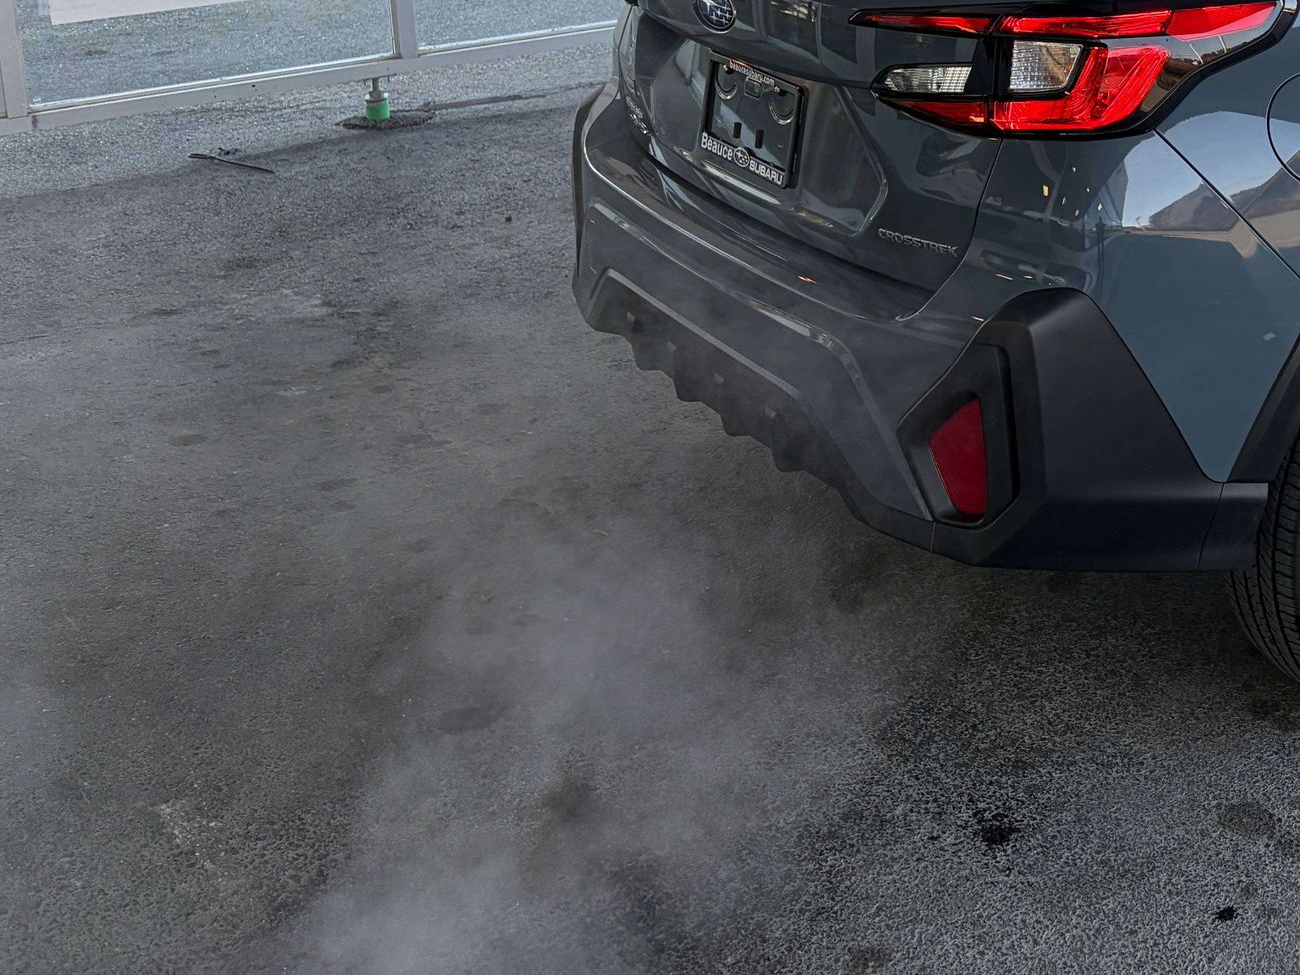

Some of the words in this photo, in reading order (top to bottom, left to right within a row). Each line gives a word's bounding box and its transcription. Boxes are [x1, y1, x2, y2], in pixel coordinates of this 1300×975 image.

[729, 59, 775, 87] beaucesubaru.com
[700, 131, 733, 161] Beauce
[749, 159, 785, 185] SUBARU
[878, 228, 958, 257] CROSSTREK
